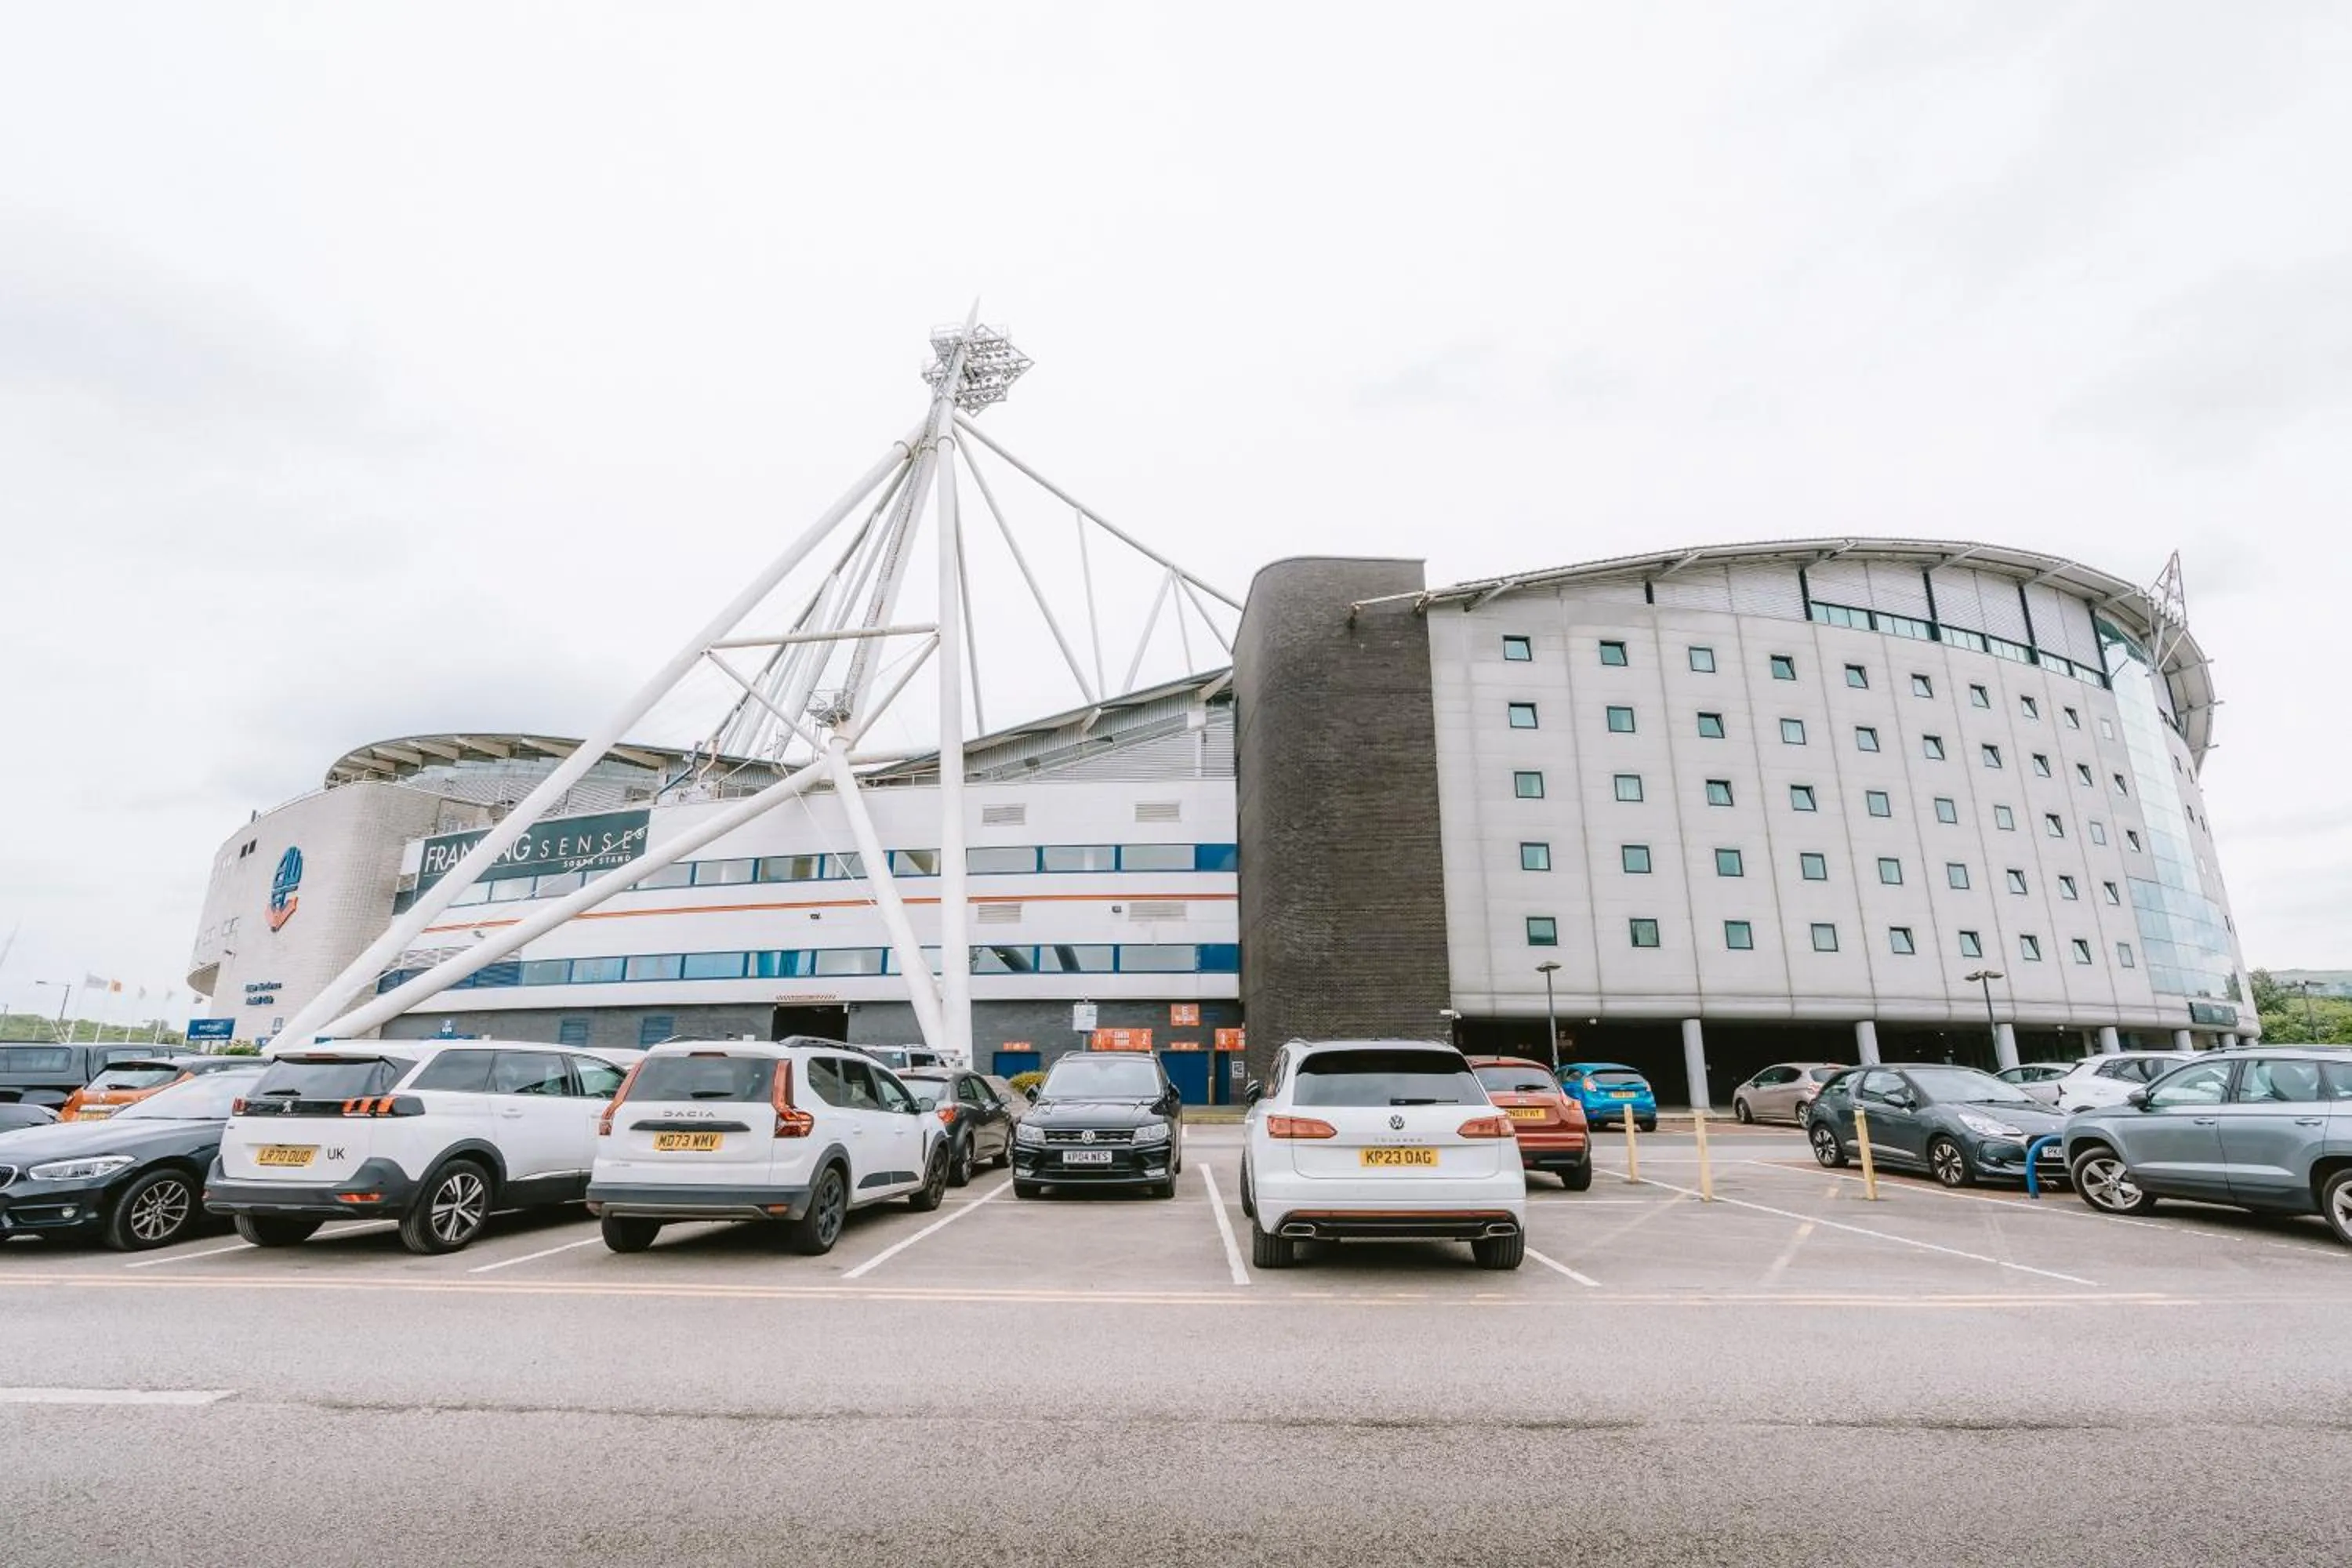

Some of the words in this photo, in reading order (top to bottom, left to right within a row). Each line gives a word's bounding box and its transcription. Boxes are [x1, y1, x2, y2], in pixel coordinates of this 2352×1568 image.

[425, 833, 532, 873] FRANNG
[598, 855, 630, 865] STAND
[658, 1134, 691, 1146] MD73
[327, 1148, 345, 1160] UK
[1365, 1150, 1401, 1163] KP23
